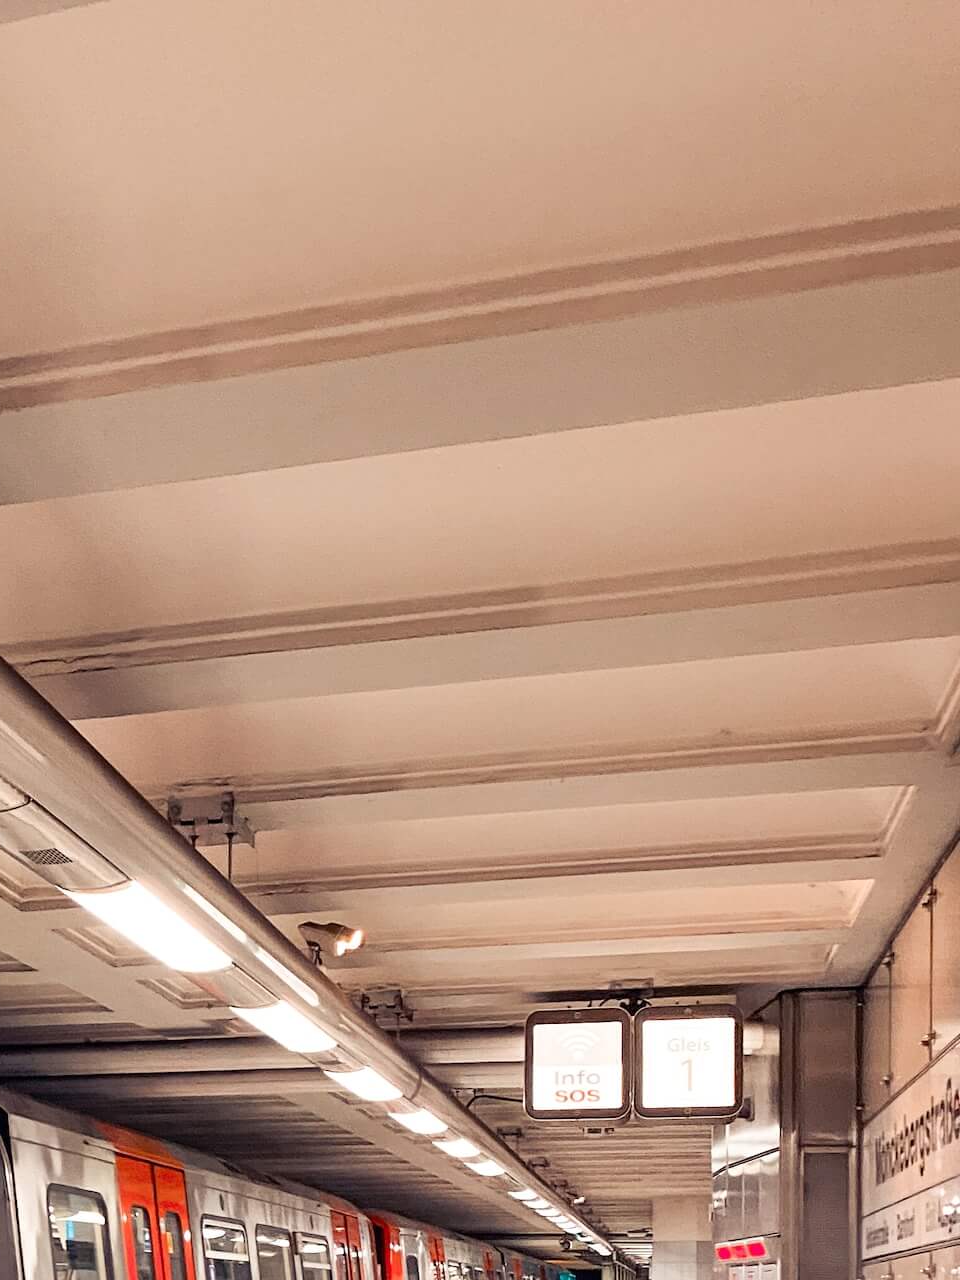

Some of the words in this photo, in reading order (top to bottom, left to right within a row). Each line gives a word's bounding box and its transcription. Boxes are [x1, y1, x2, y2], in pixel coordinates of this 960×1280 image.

[667, 1037, 711, 1053] Gleis
[554, 1070, 601, 1086] Info
[681, 1058, 694, 1092] 1
